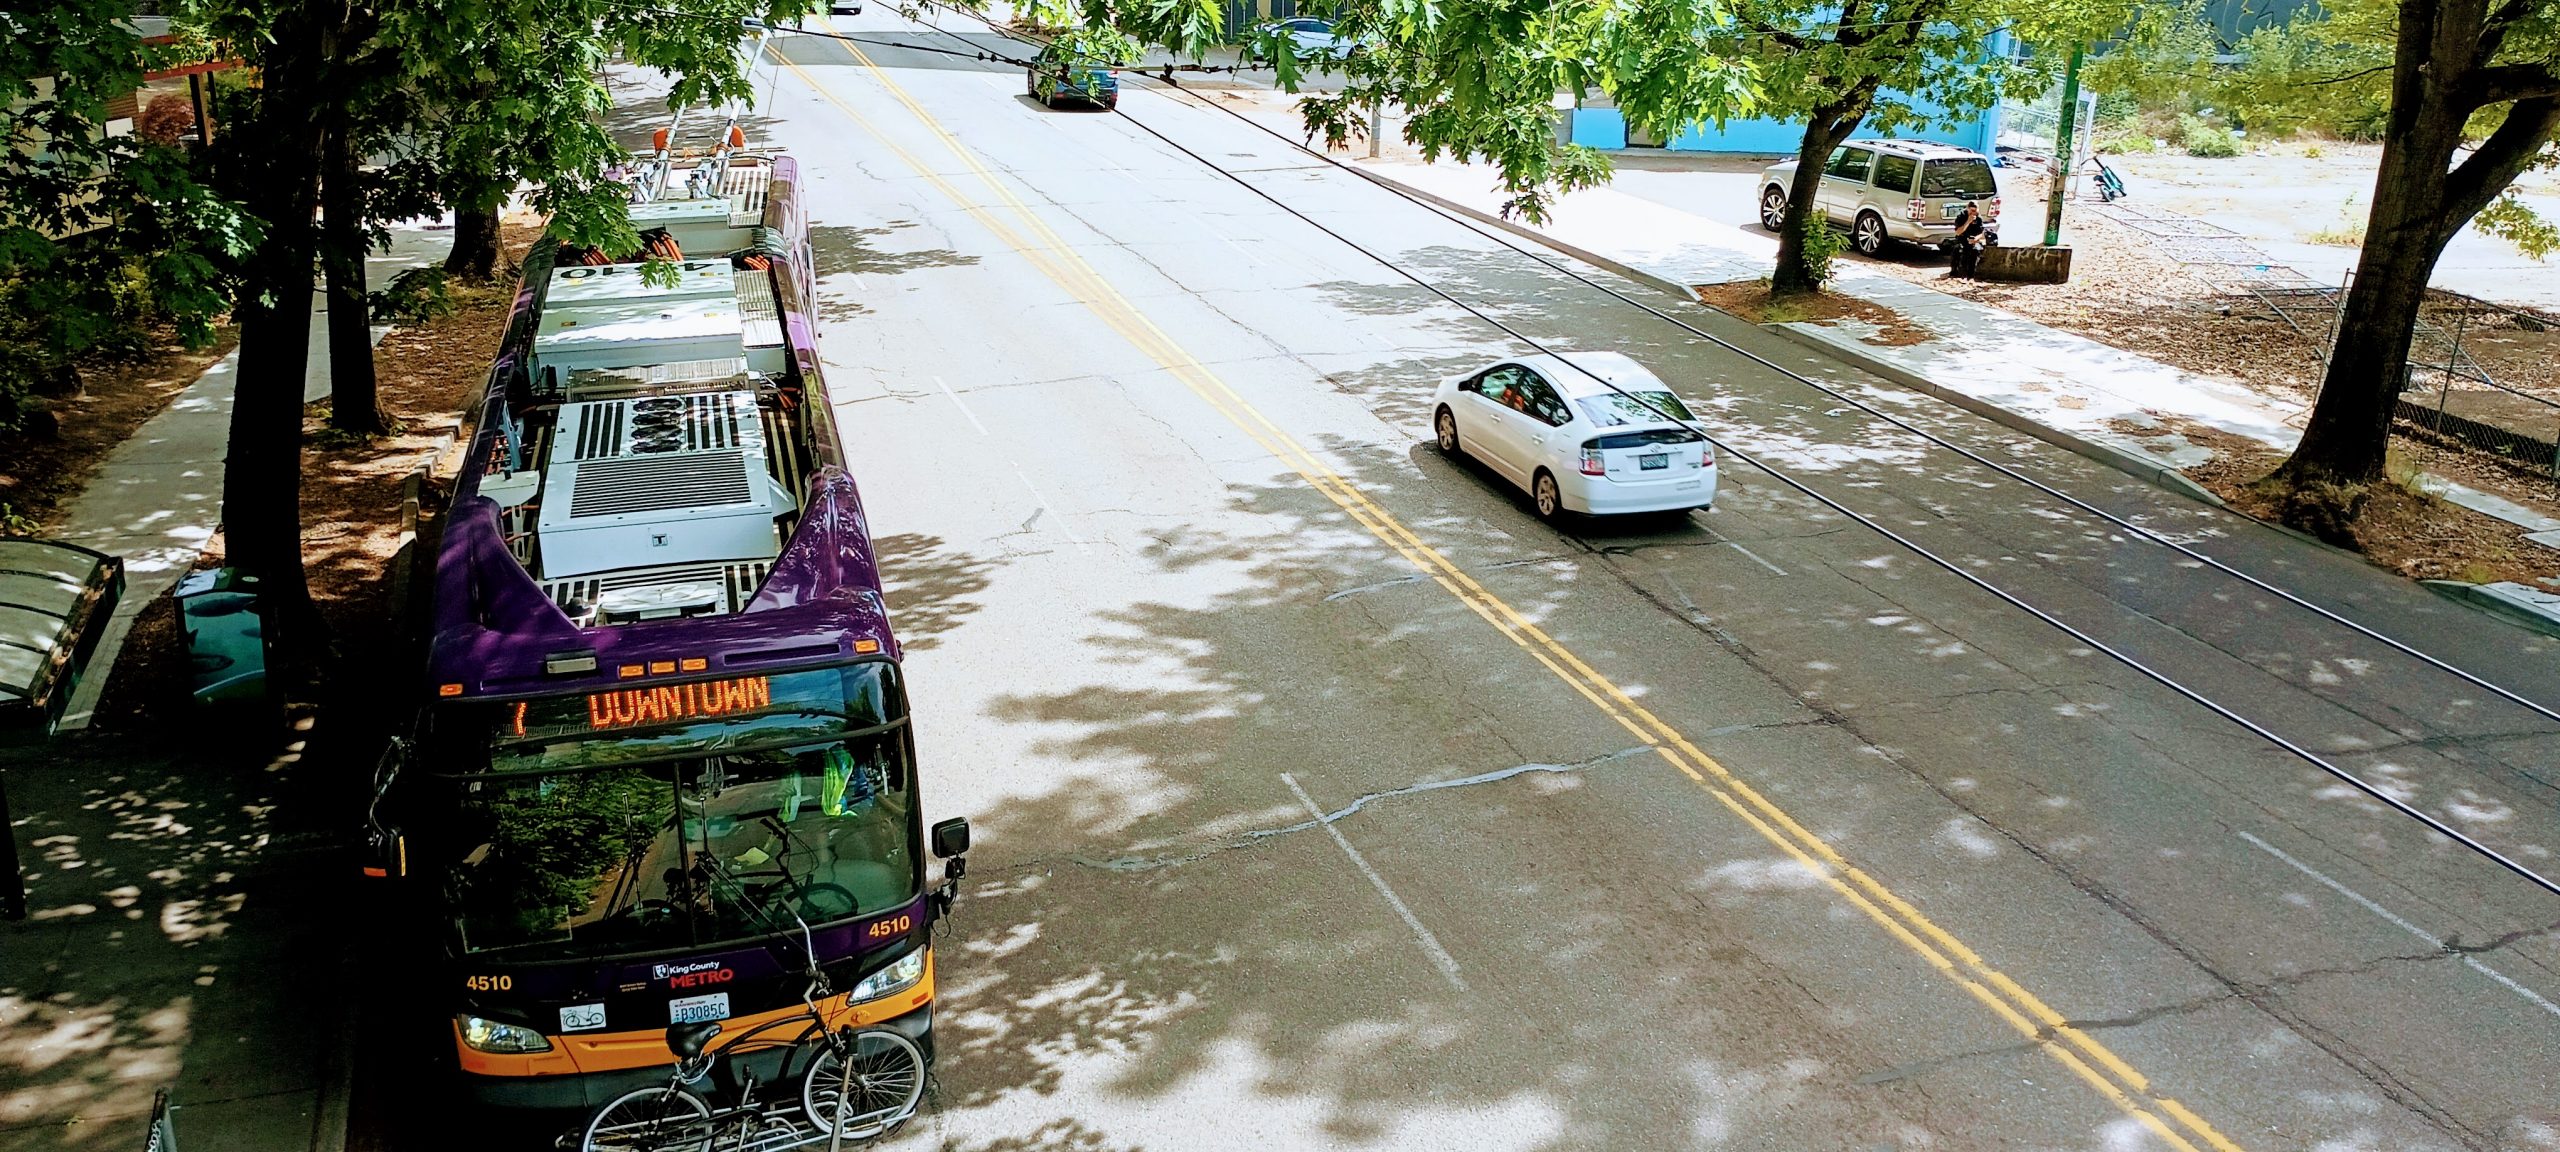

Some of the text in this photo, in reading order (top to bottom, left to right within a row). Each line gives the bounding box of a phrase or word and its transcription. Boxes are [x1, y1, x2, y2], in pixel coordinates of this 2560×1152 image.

[590, 676, 770, 729] DOWNTOWN
[869, 915, 910, 937] 4510
[669, 961, 720, 974] King County
[466, 975, 512, 991] 4510
[670, 968, 734, 989] METRO
[680, 1002, 726, 1021] B3085C
